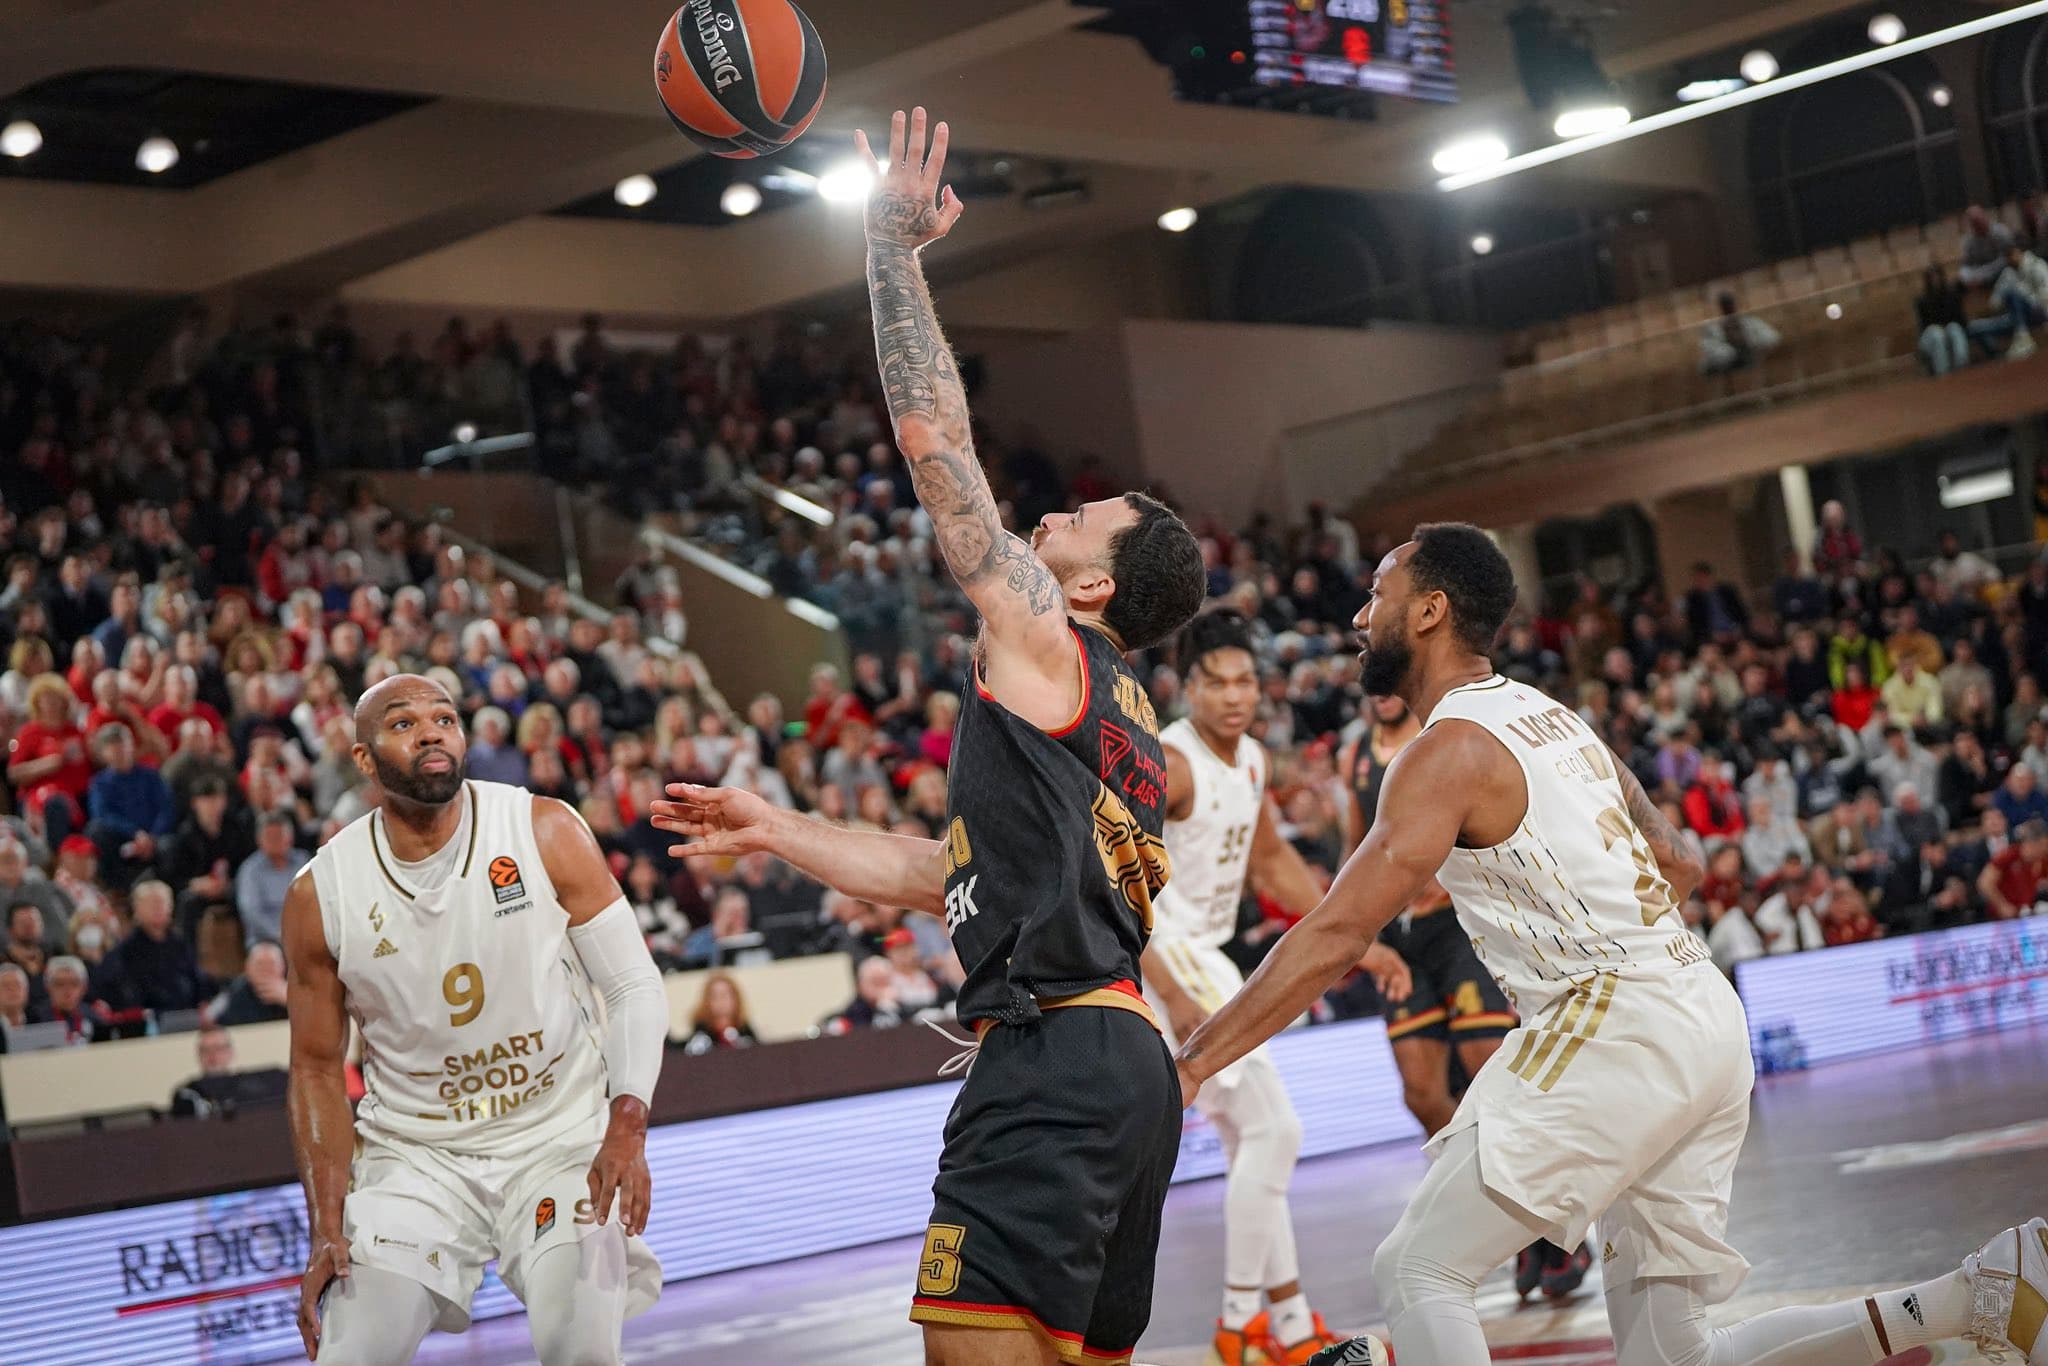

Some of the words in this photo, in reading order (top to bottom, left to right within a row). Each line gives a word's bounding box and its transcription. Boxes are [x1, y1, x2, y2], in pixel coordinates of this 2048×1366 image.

[689, 0, 743, 94] PALDING
[442, 962, 485, 1028] 9
[438, 1063, 529, 1100] GOOD
[444, 1030, 544, 1076] SMART
[447, 1073, 555, 1122] THINGS
[917, 1222, 967, 1296] 5
